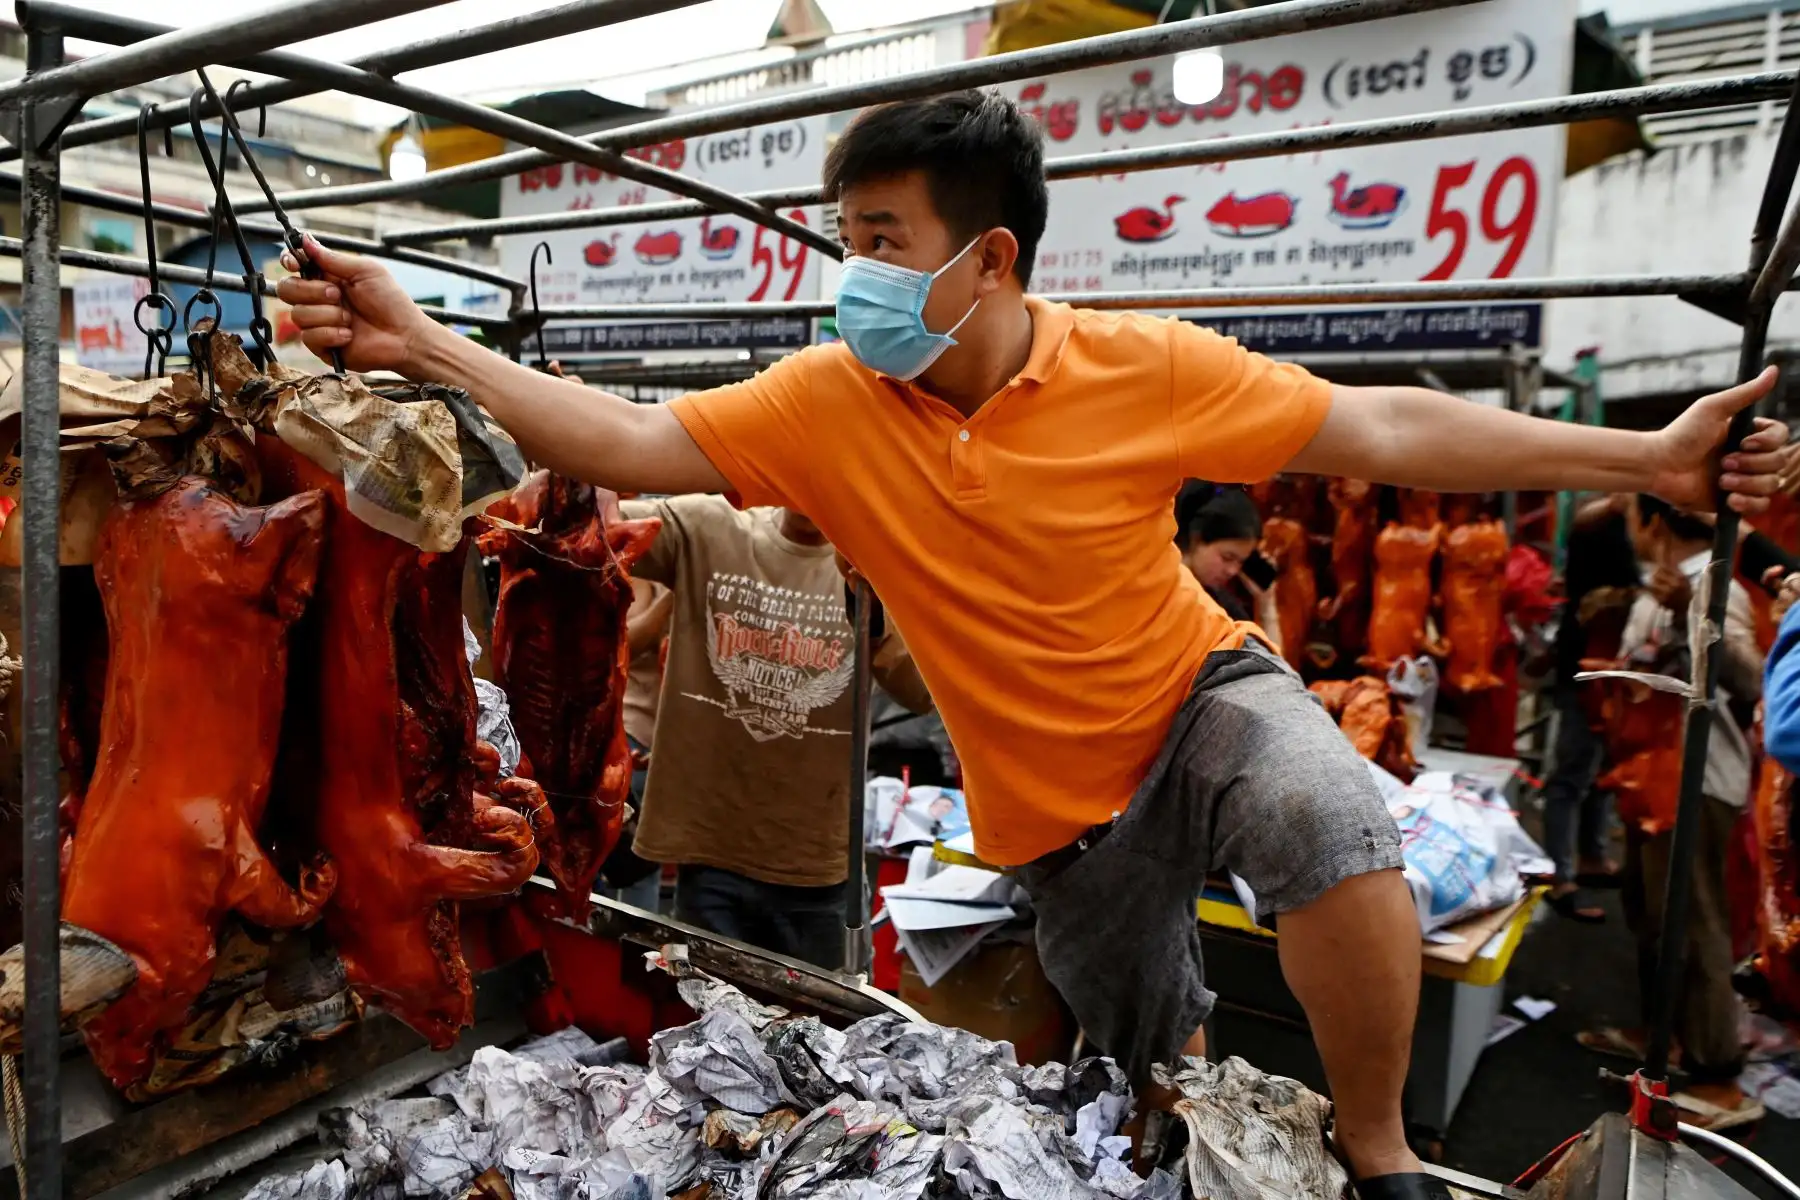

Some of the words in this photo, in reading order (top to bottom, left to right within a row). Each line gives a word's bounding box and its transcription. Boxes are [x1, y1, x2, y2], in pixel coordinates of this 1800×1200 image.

[1417, 155, 1539, 280] 59
[746, 207, 808, 302] 59
[717, 585, 735, 602] OF
[760, 596, 805, 619] GREAT
[734, 610, 779, 632] CONCERT
